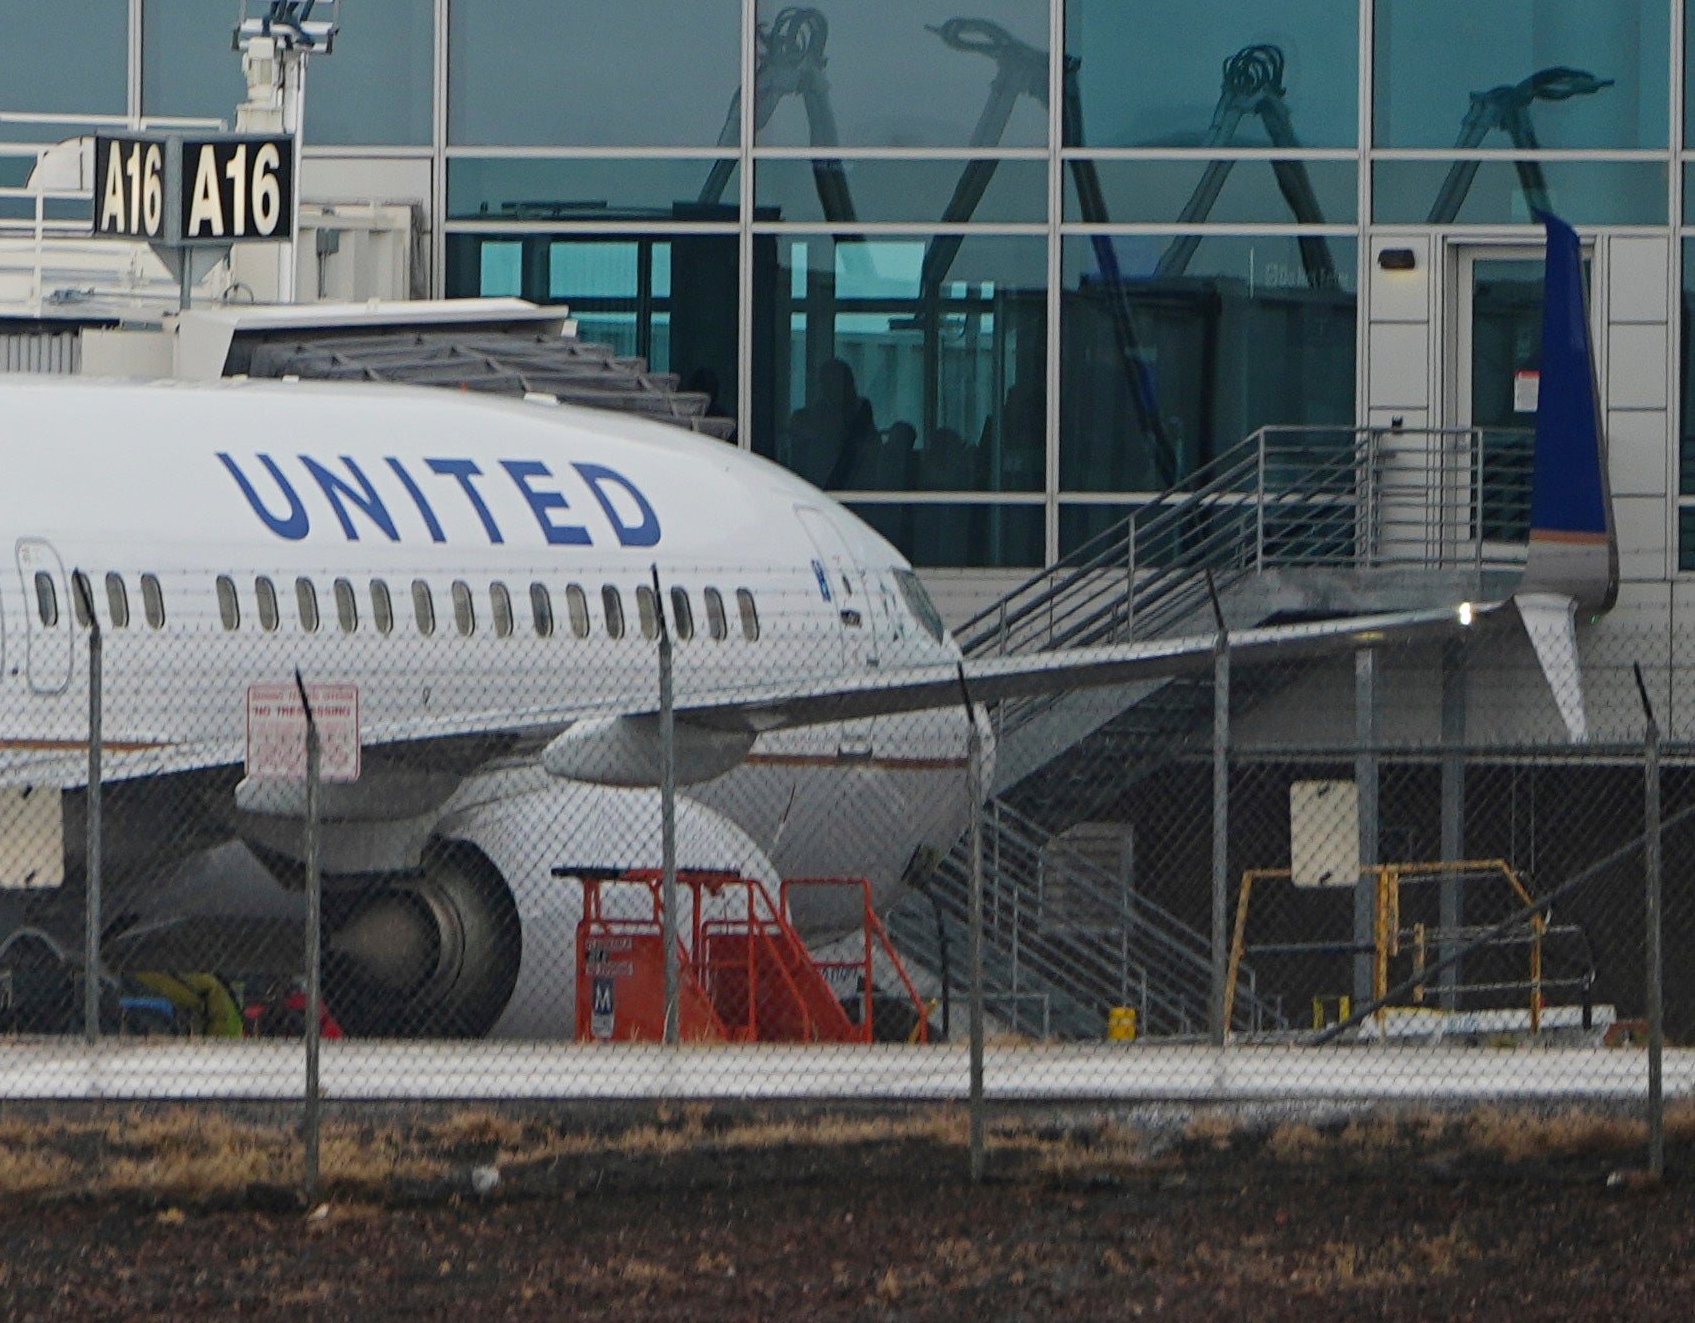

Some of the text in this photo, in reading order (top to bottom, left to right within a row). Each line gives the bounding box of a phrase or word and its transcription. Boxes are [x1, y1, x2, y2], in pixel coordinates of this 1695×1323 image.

[101, 140, 161, 236] A16
[188, 143, 280, 236] A16
[214, 452, 661, 547] UNITED
